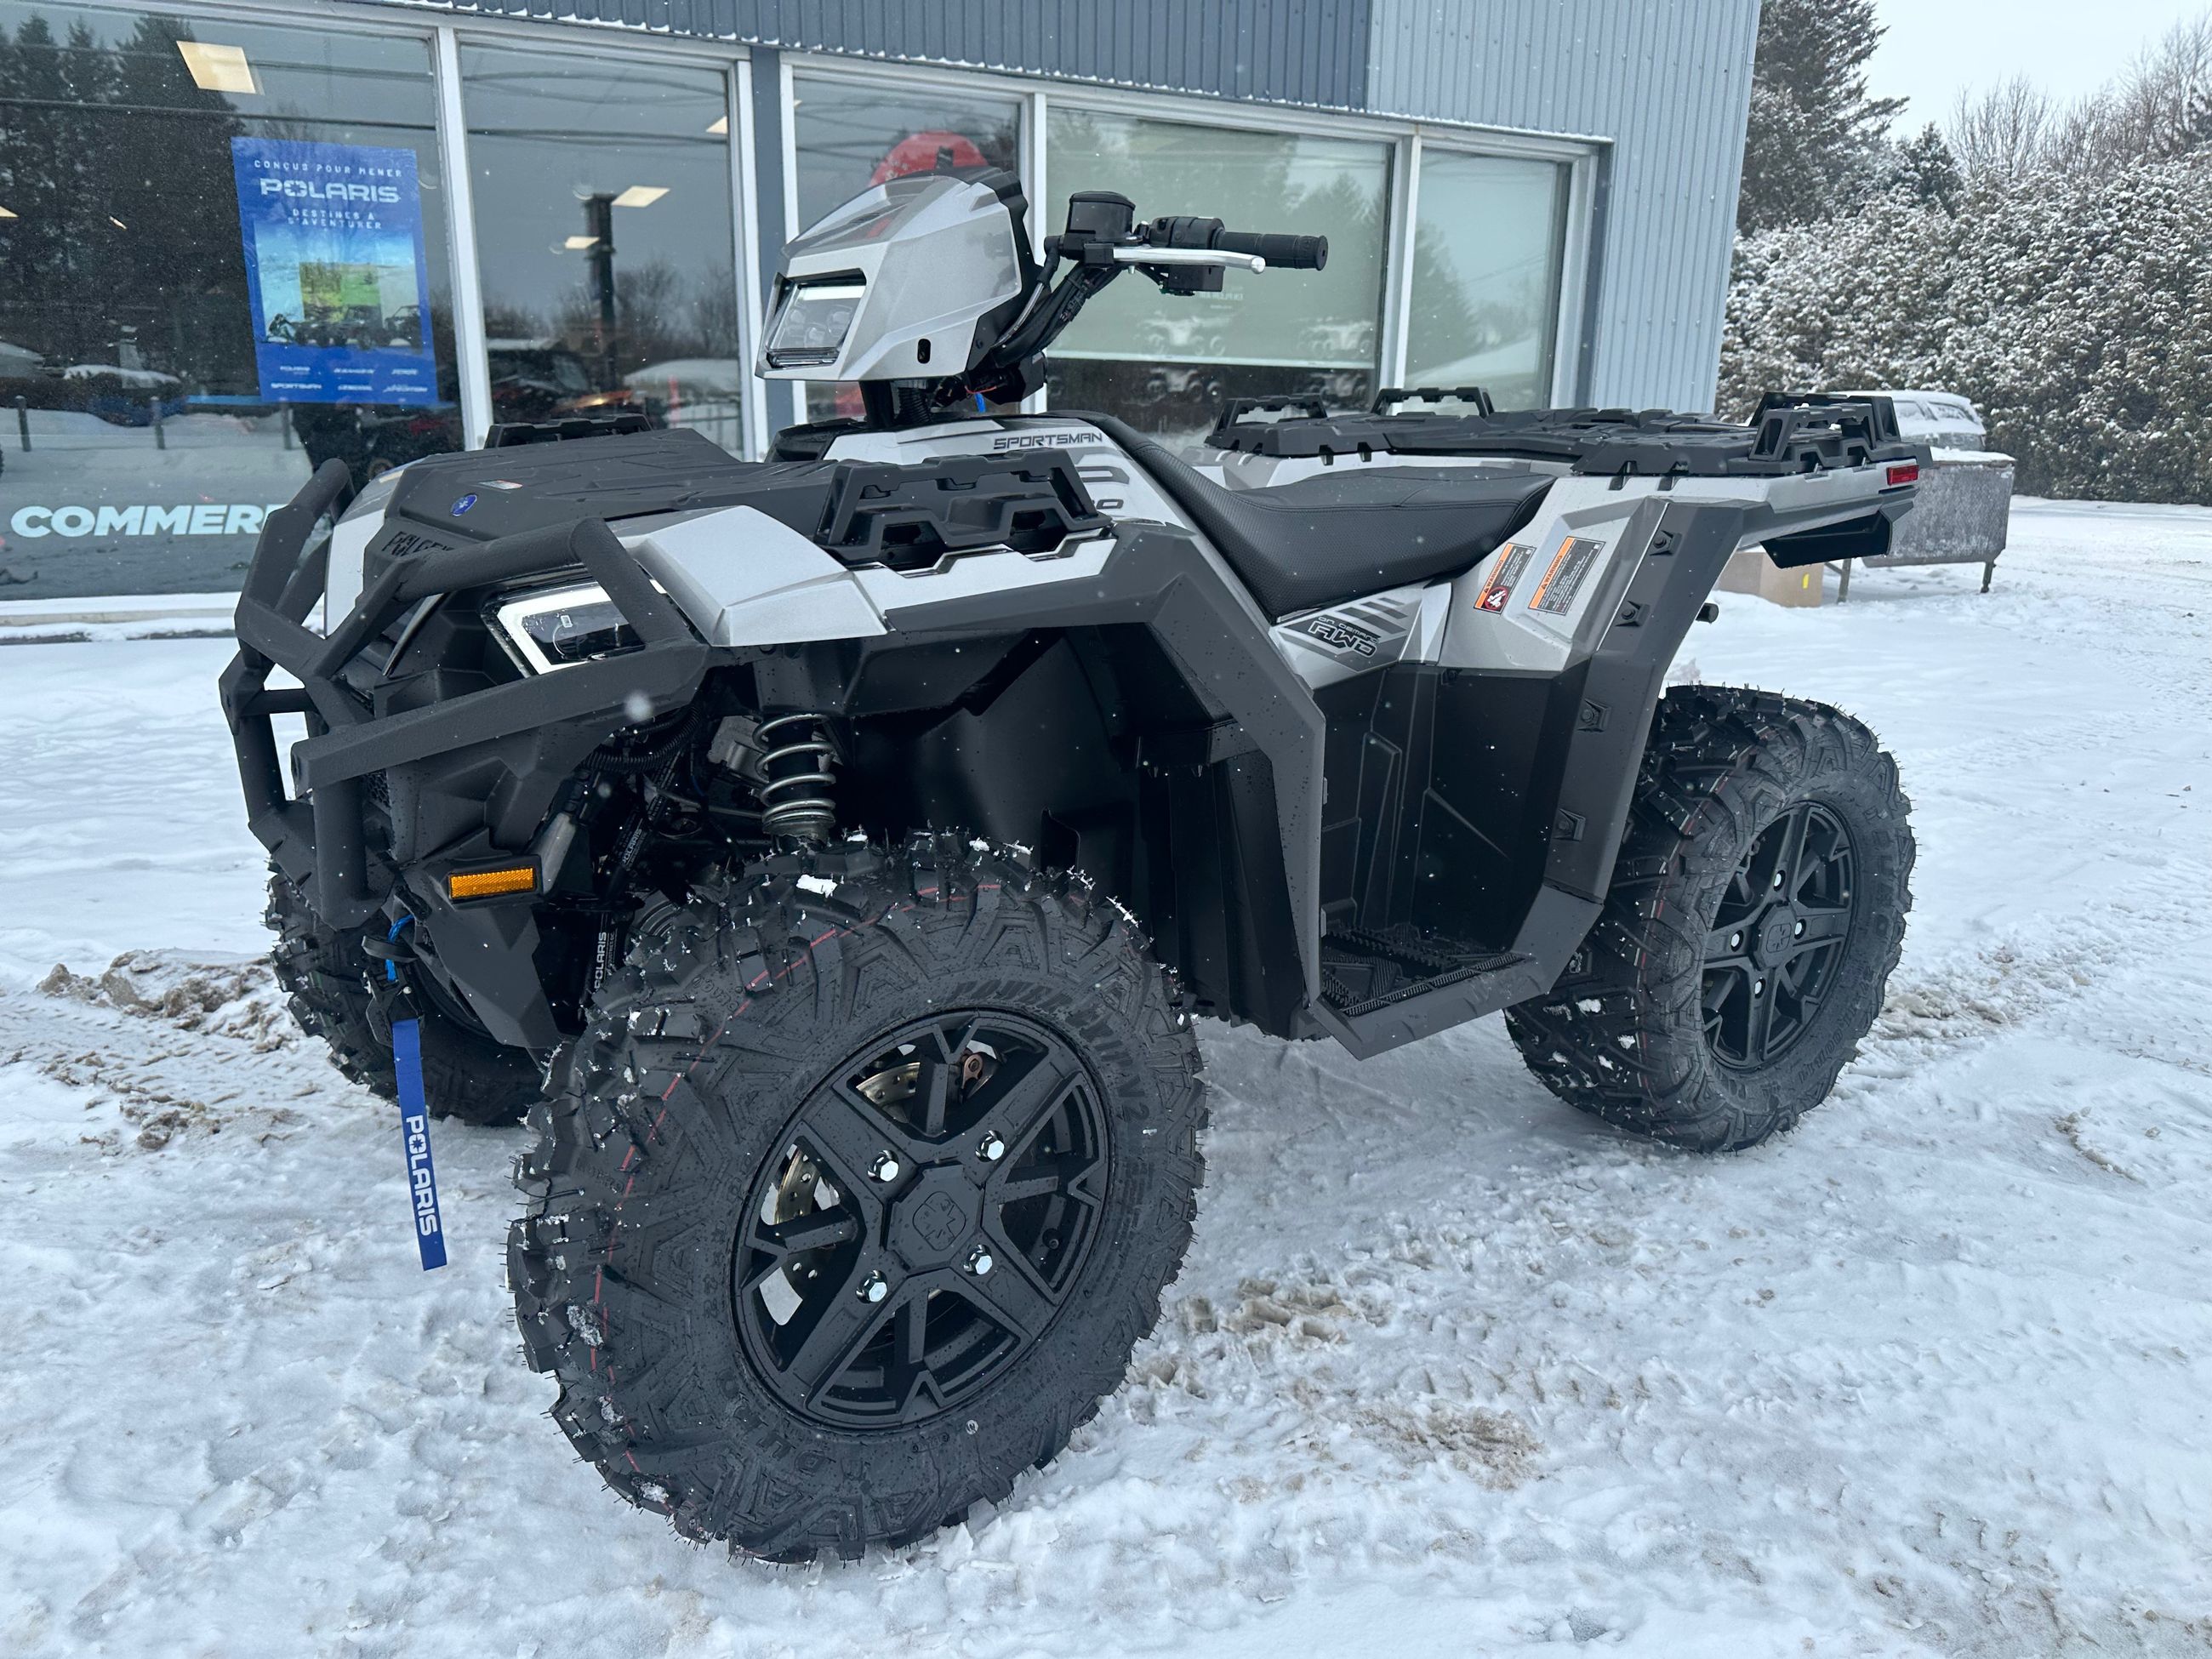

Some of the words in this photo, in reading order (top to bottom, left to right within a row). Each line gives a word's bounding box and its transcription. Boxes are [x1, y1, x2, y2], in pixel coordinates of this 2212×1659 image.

[316, 163, 351, 174] POUR
[359, 167, 402, 178] MENER
[259, 178, 401, 203] POLARIS
[993, 432, 1103, 450] SPORTSMAN
[11, 504, 289, 538] COMMER
[1487, 559, 1504, 587] WARNING
[1545, 555, 1563, 585] WARNING
[1318, 616, 1336, 625] ON
[1308, 620, 1378, 658] AWD
[594, 932, 607, 990] POLARIS
[406, 1115, 438, 1236] POLARIS
